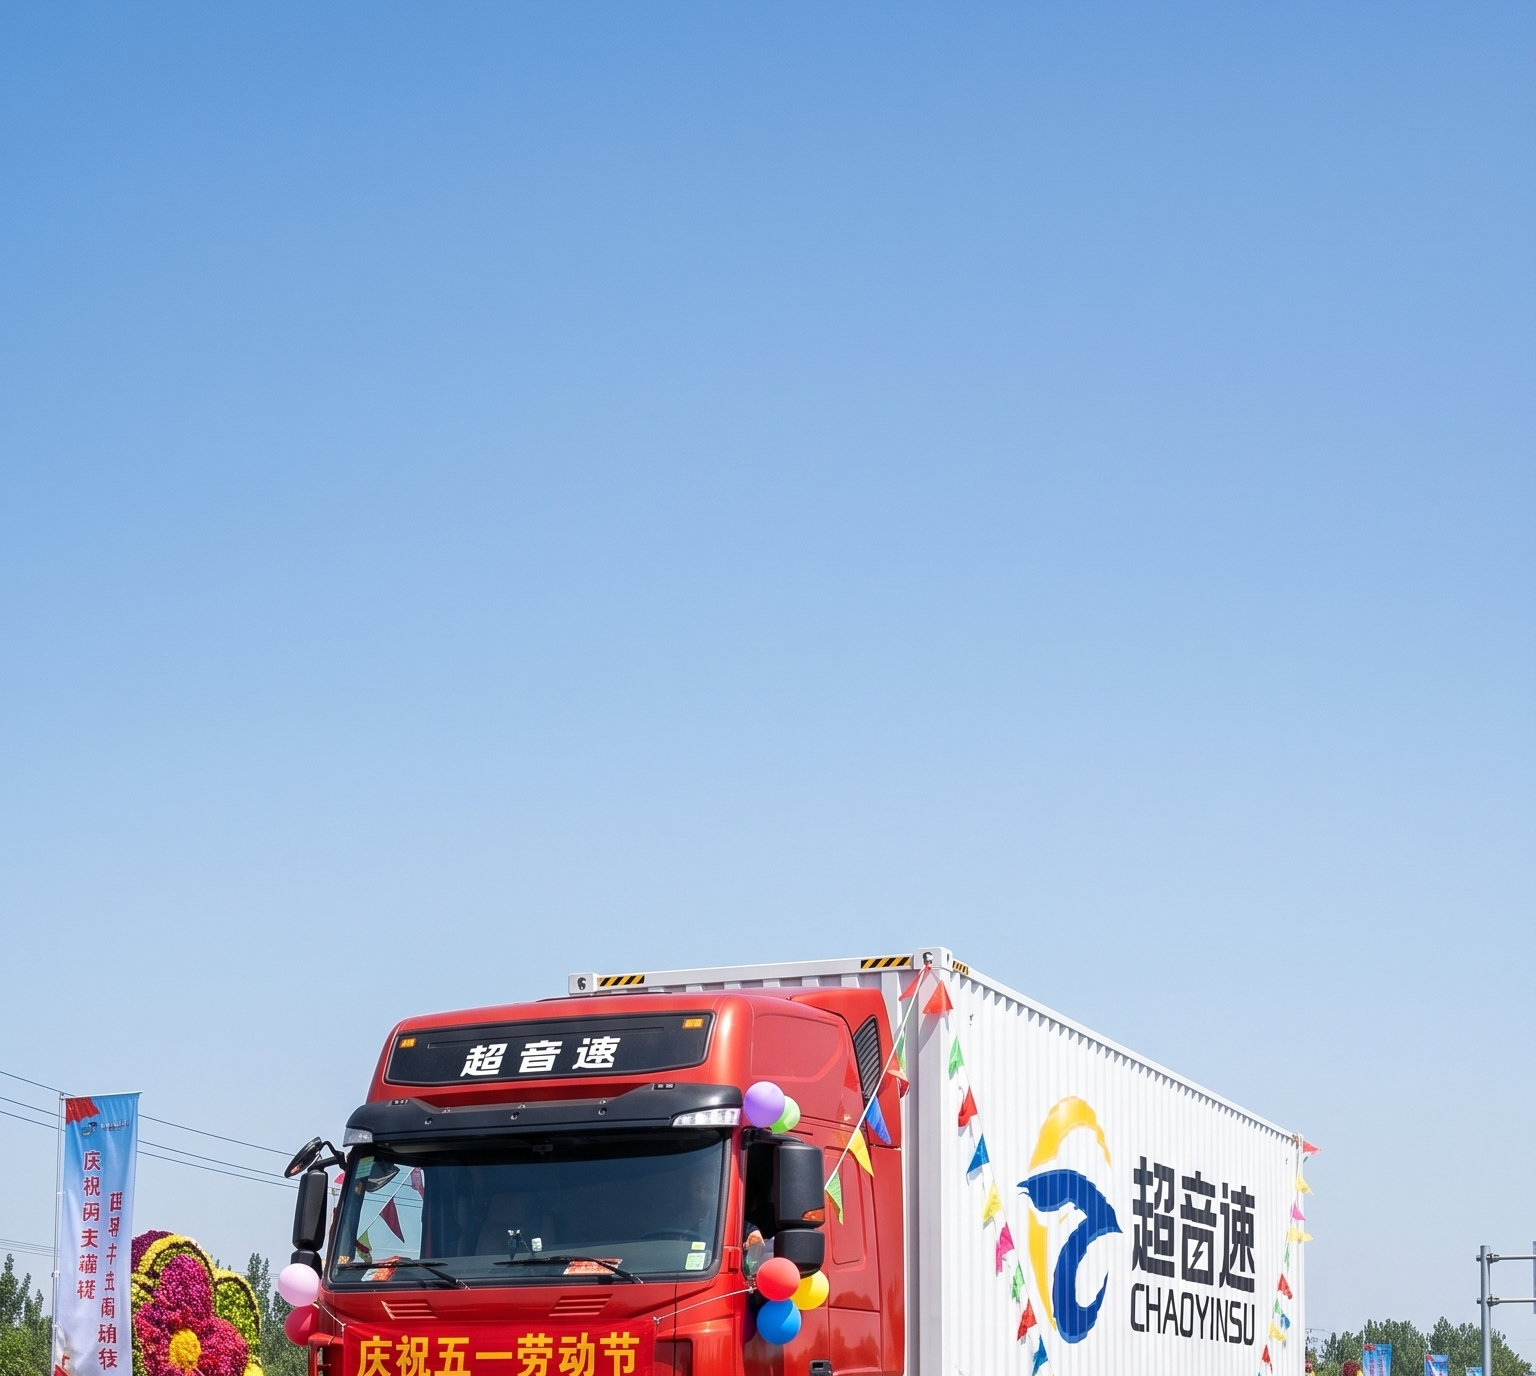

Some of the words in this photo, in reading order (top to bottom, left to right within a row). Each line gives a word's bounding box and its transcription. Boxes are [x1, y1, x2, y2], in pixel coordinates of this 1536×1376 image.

[460, 1036, 621, 1077] 超音速
[1132, 1155, 1256, 1293] 超音速
[1130, 1282, 1256, 1346] CHAOYINSU
